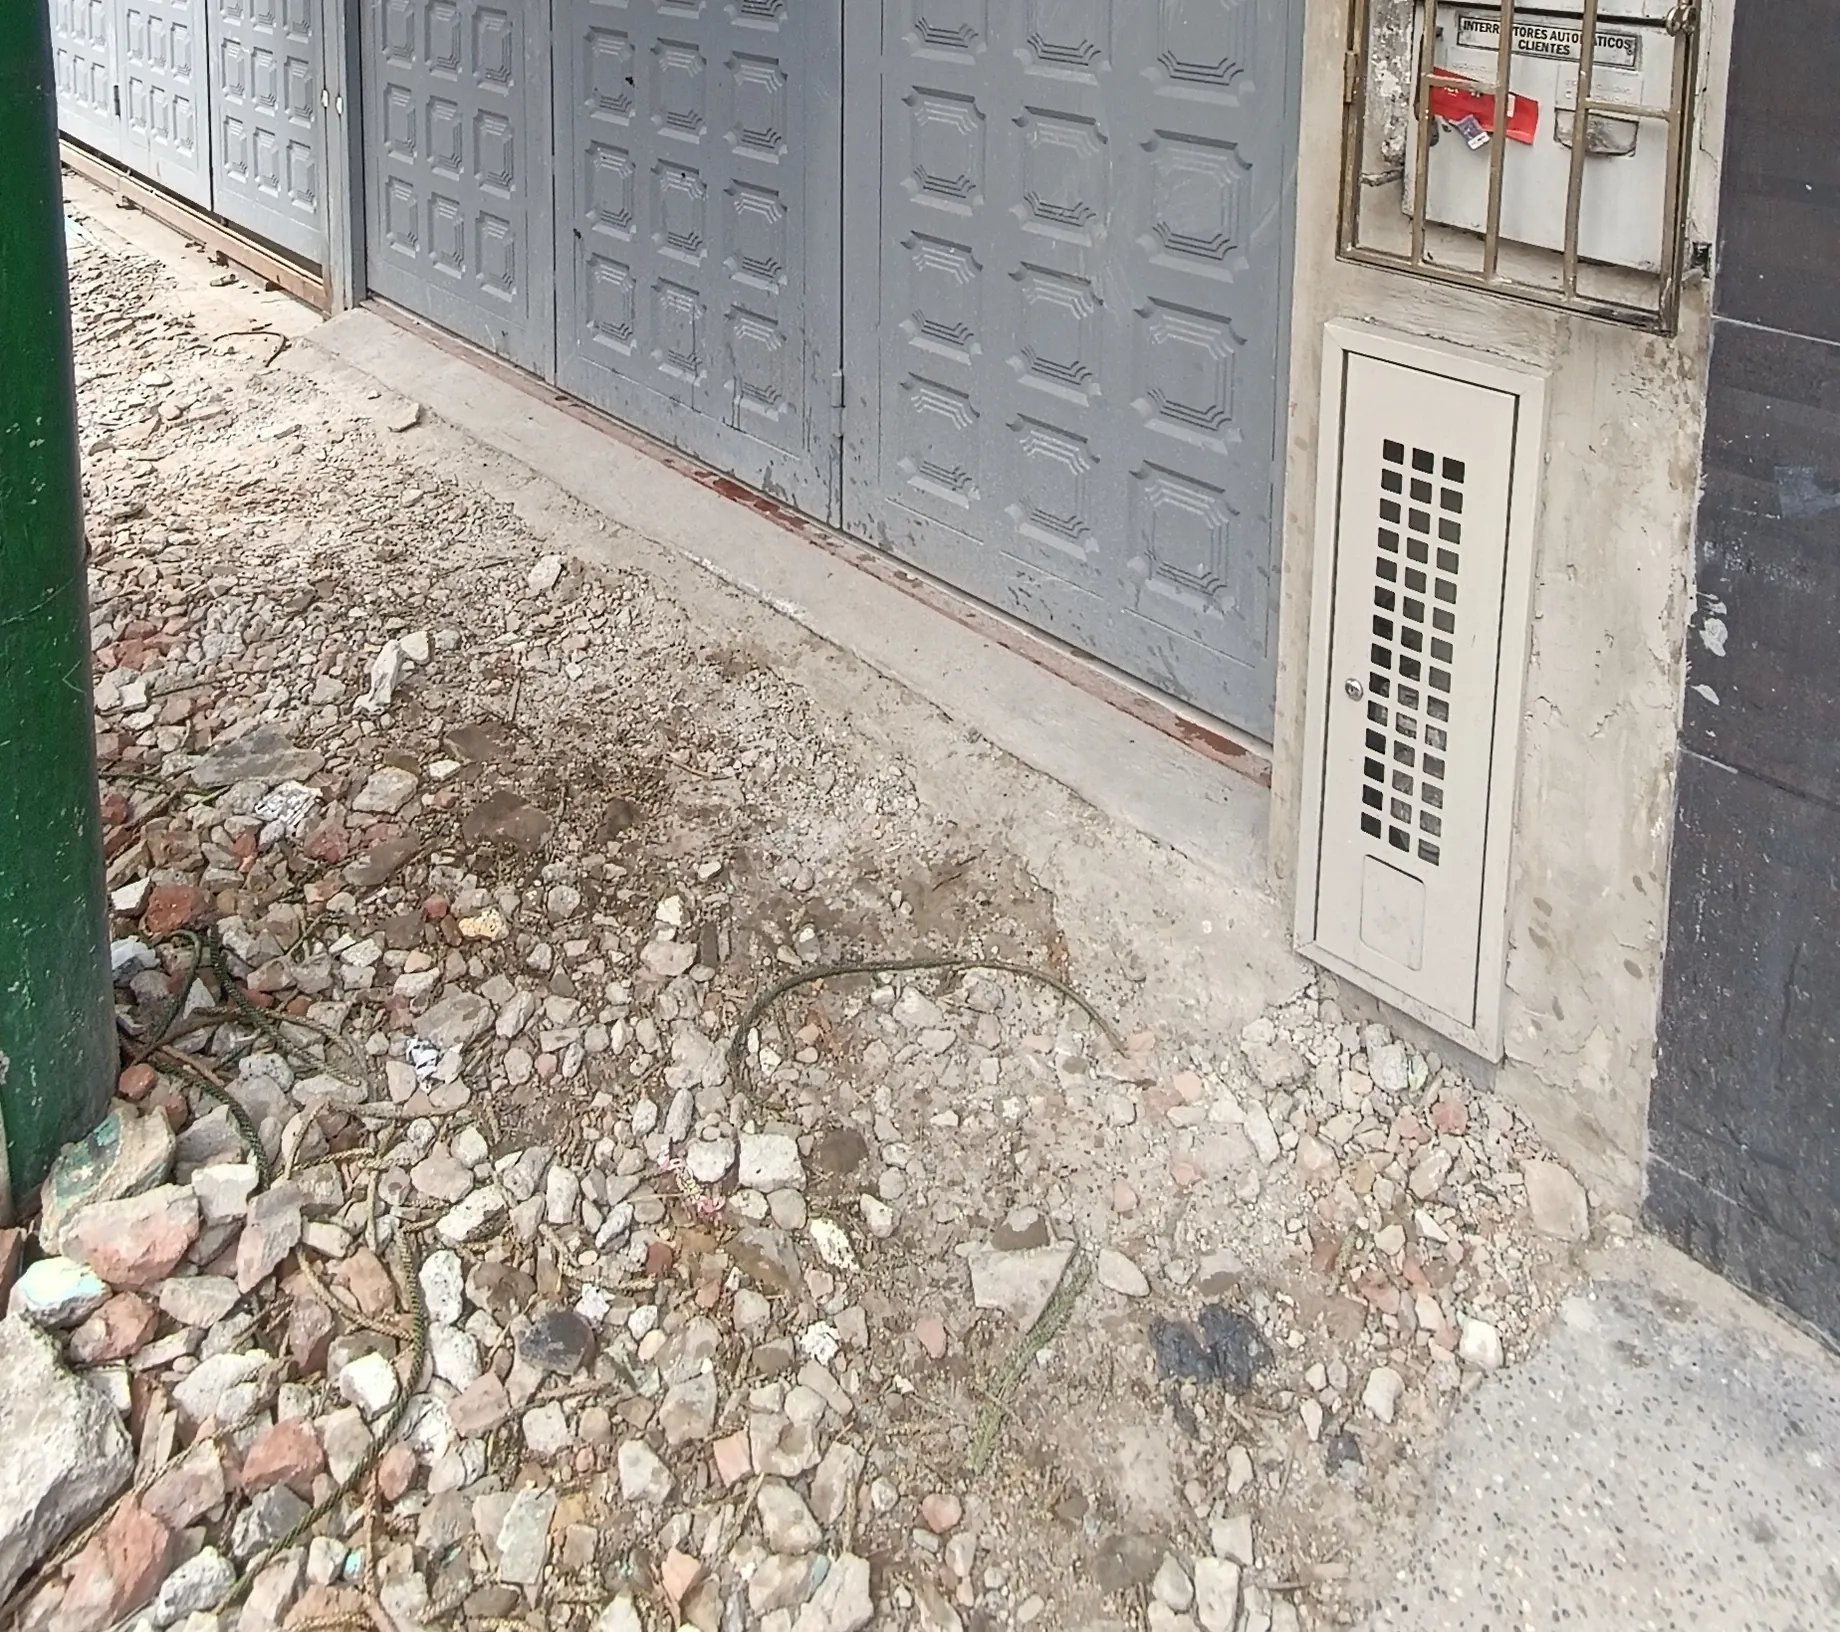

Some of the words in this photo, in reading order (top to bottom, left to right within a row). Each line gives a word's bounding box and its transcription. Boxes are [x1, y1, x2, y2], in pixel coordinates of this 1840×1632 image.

[1463, 20, 1548, 40] INTERRTORES
[1550, 31, 1632, 50] AUTOTICOS
[1518, 39, 1570, 56] CLIENTES
